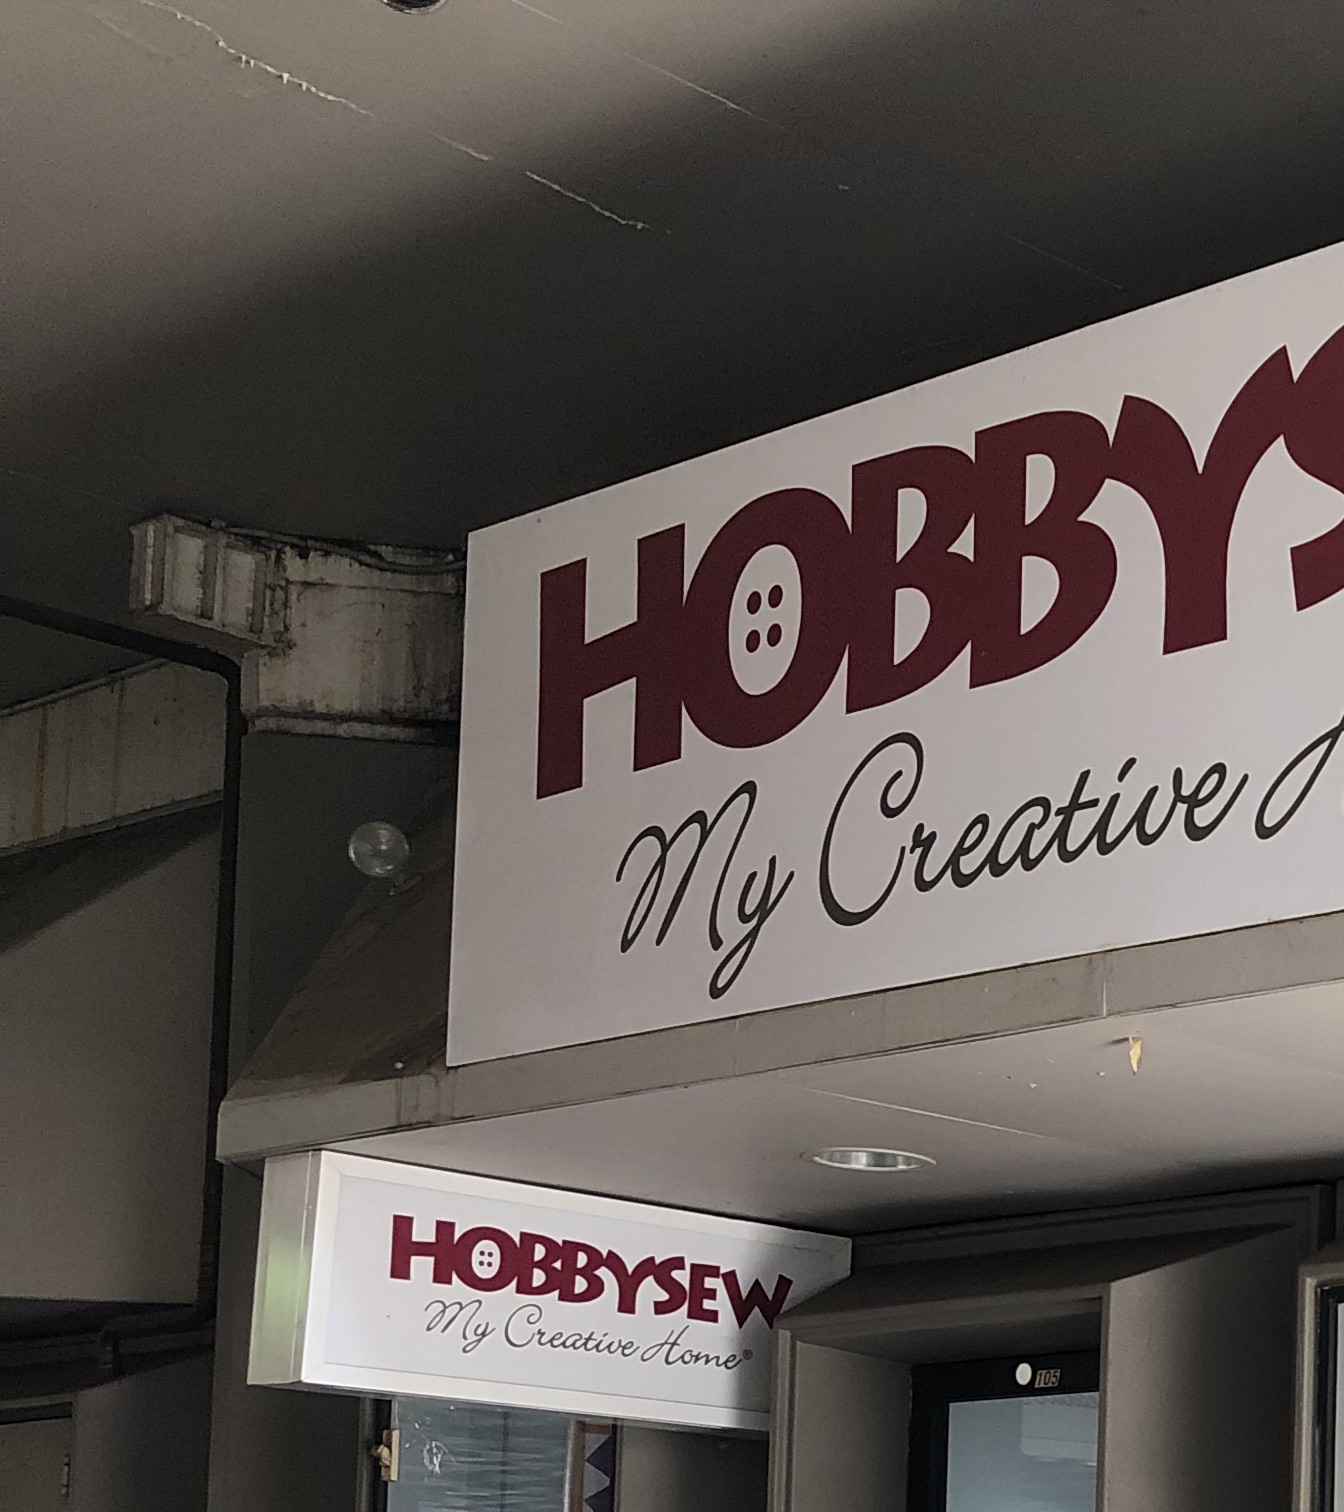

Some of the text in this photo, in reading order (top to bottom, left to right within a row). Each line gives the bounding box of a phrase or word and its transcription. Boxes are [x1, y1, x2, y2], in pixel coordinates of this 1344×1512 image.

[616, 779, 797, 998] My
[818, 732, 1250, 927] Creative
[389, 1214, 794, 1330] HOBBYSEW
[424, 1300, 496, 1354] My
[504, 1302, 640, 1358] Creative
[1037, 1370, 1059, 1386] 105
